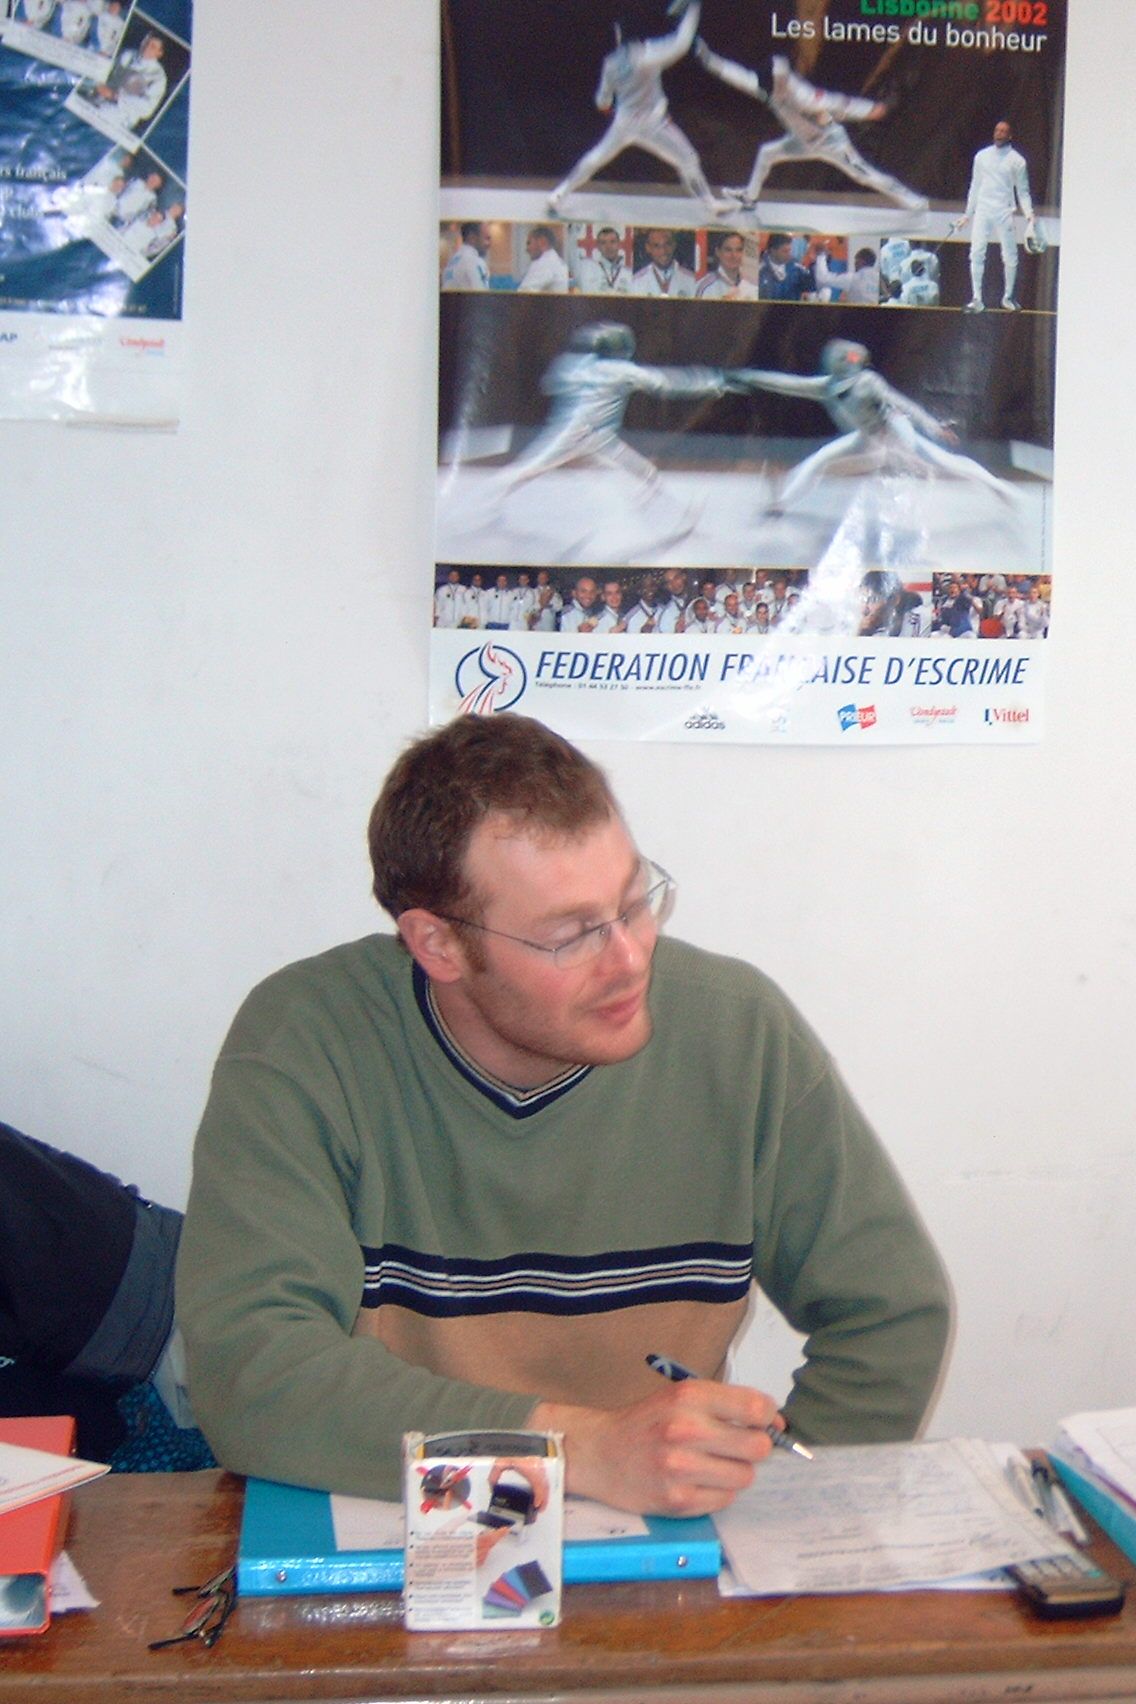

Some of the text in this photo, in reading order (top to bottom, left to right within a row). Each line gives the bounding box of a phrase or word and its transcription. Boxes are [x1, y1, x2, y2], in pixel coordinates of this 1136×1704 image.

[860, 0, 1047, 25] Lisbonne 2002
[771, 13, 1047, 51] Les lames du bonheur
[535, 651, 710, 681] FEDERATION
[884, 656, 1030, 686] D'ESCRIME
[684, 718, 726, 730] adidas
[993, 708, 1030, 722] Vittel
